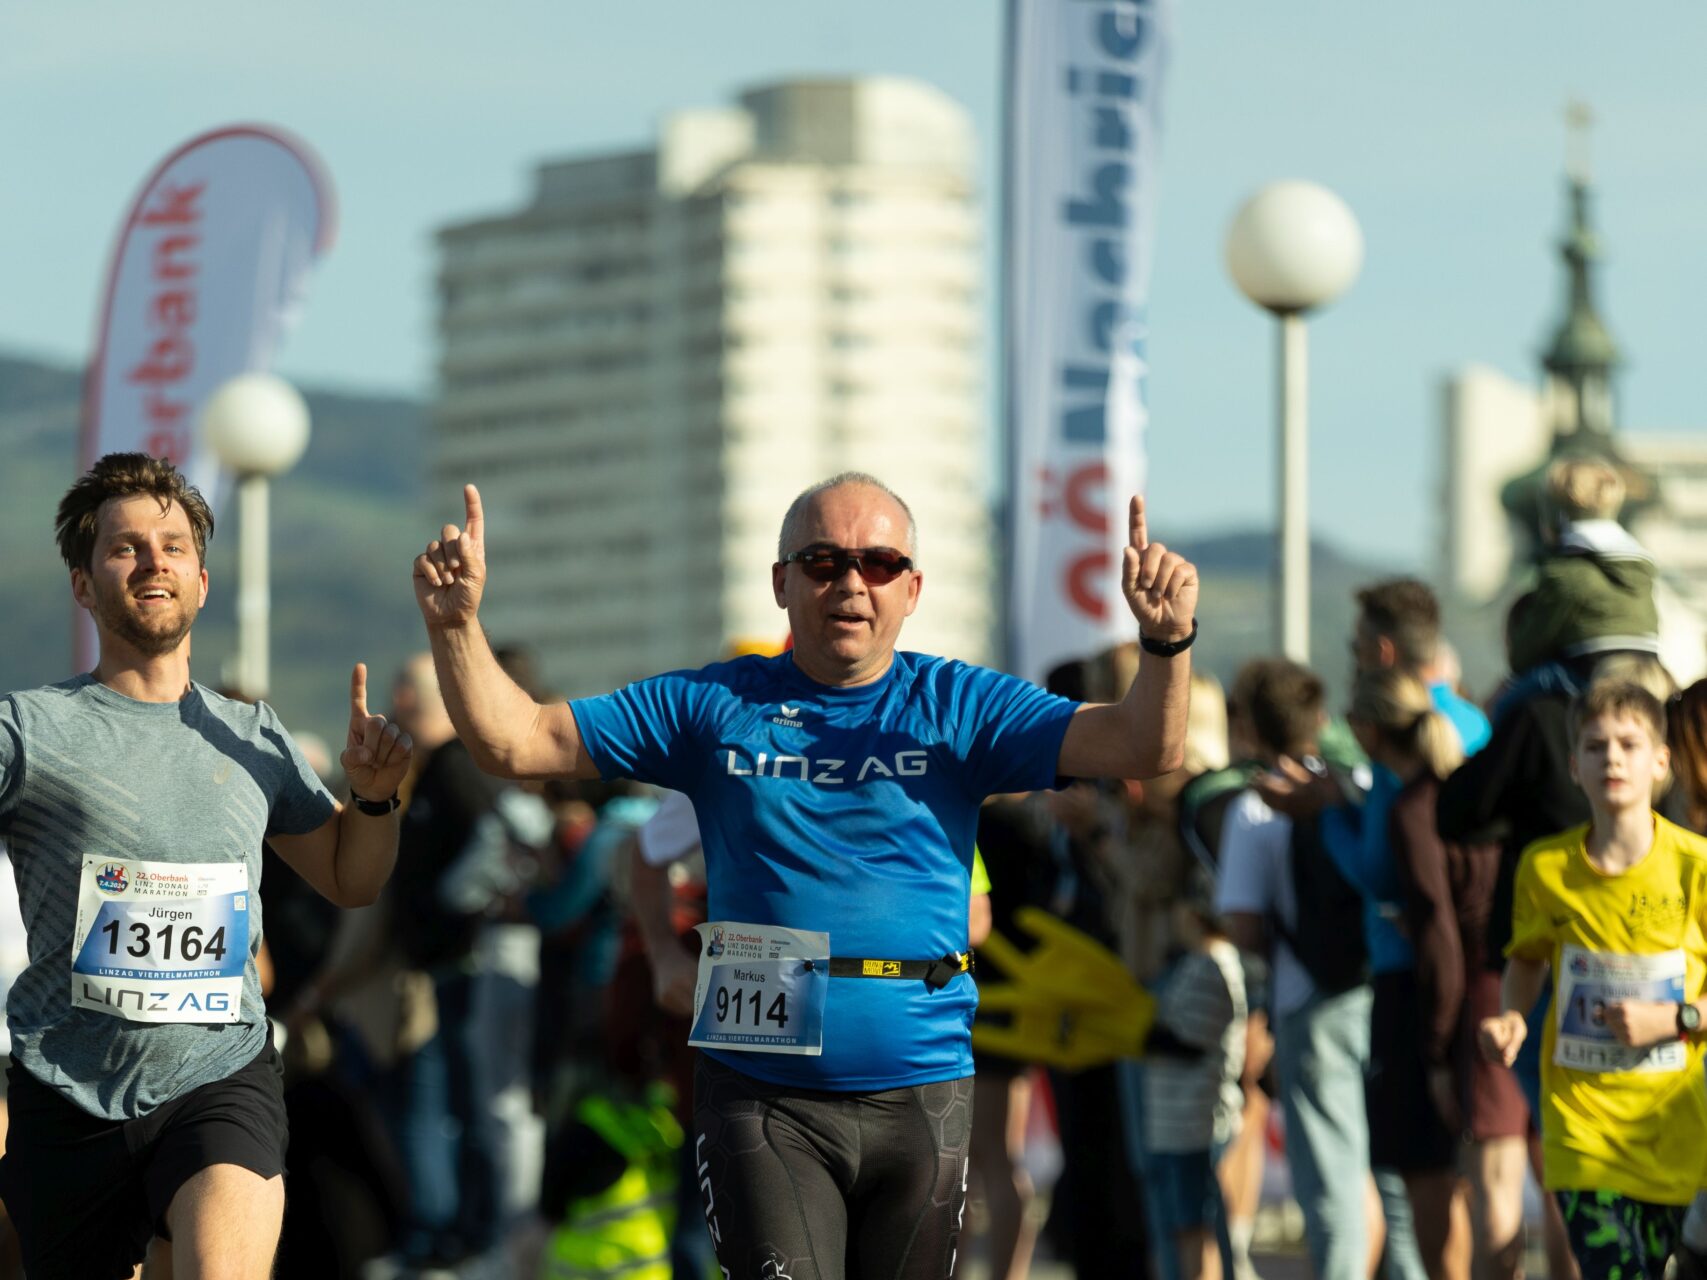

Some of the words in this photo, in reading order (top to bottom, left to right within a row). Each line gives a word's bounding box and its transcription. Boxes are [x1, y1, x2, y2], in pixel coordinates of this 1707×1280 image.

[1034, 0, 1148, 622] OÖNachric
[772, 716, 803, 728] erima
[727, 750, 845, 784] LINZ
[857, 750, 928, 781] AG
[135, 872, 148, 880] 22.
[150, 873, 188, 882] Oberbank
[135, 880, 153, 888] LINZ
[158, 882, 189, 890] DONAU
[134, 888, 188, 897] MARATHON
[149, 907, 192, 921] Jürgen
[102, 919, 226, 962] 13164
[727, 950, 762, 959] MARATHON
[138, 970, 221, 979] VIERTELMARATHON
[733, 969, 766, 983] Markus
[83, 983, 170, 1012] LINZ
[177, 992, 230, 1012] AG
[716, 985, 789, 1029] 9114
